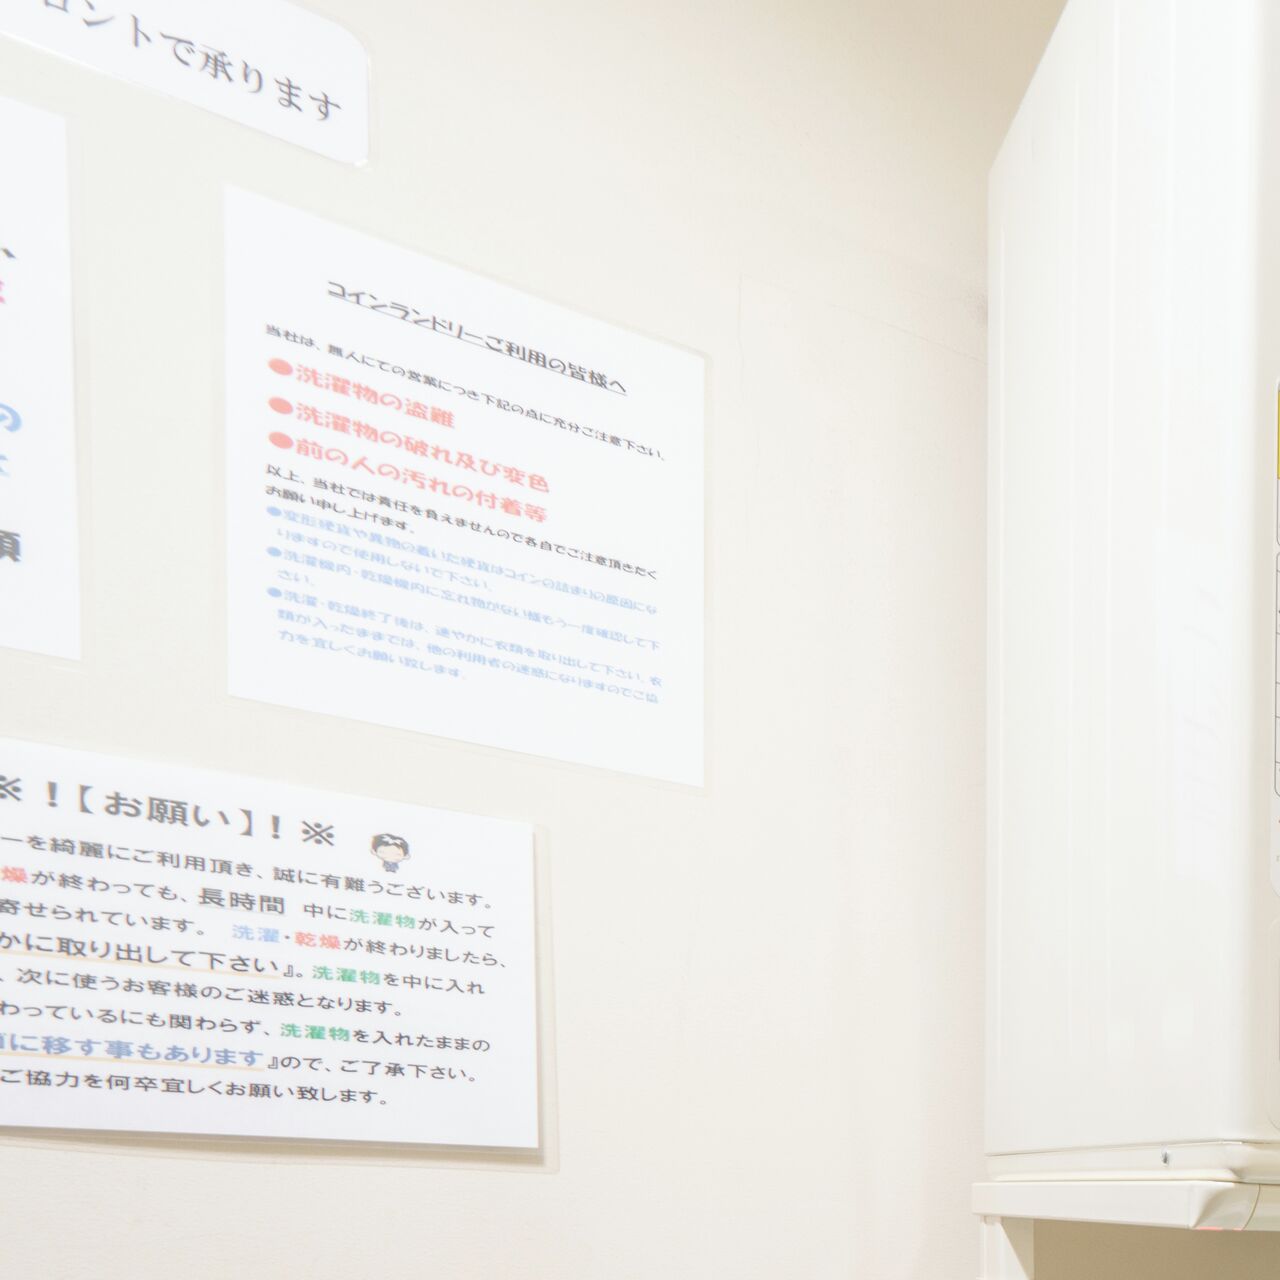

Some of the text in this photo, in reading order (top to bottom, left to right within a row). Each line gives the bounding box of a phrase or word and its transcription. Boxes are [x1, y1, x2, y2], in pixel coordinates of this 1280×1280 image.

[327, 281, 627, 394] コインランドリーご利用の皆様へ
[296, 362, 456, 430] 洗濯物の盗難
[295, 438, 548, 524] 前の人の汚れの付着等
[296, 402, 551, 494] 洗濯物の破れ及び変色
[265, 484, 416, 534] お願い申し上げます。
[265, 463, 657, 582] 以上、当社では責任を負えませんので各自でご注意頂きたく
[0, 833, 494, 910] ーを綺麗にご利用頂き、誠に有難うございます。
[232, 923, 507, 969] 洗濯・乾燥が終わりましたら、
[303, 901, 496, 939] 中に洗濯物が入って
[0, 1031, 478, 1084] に移す事もあります』ので、ご了承下さい。
[0, 1069, 390, 1107] ご協力を何卒宜しくお願い致します。
